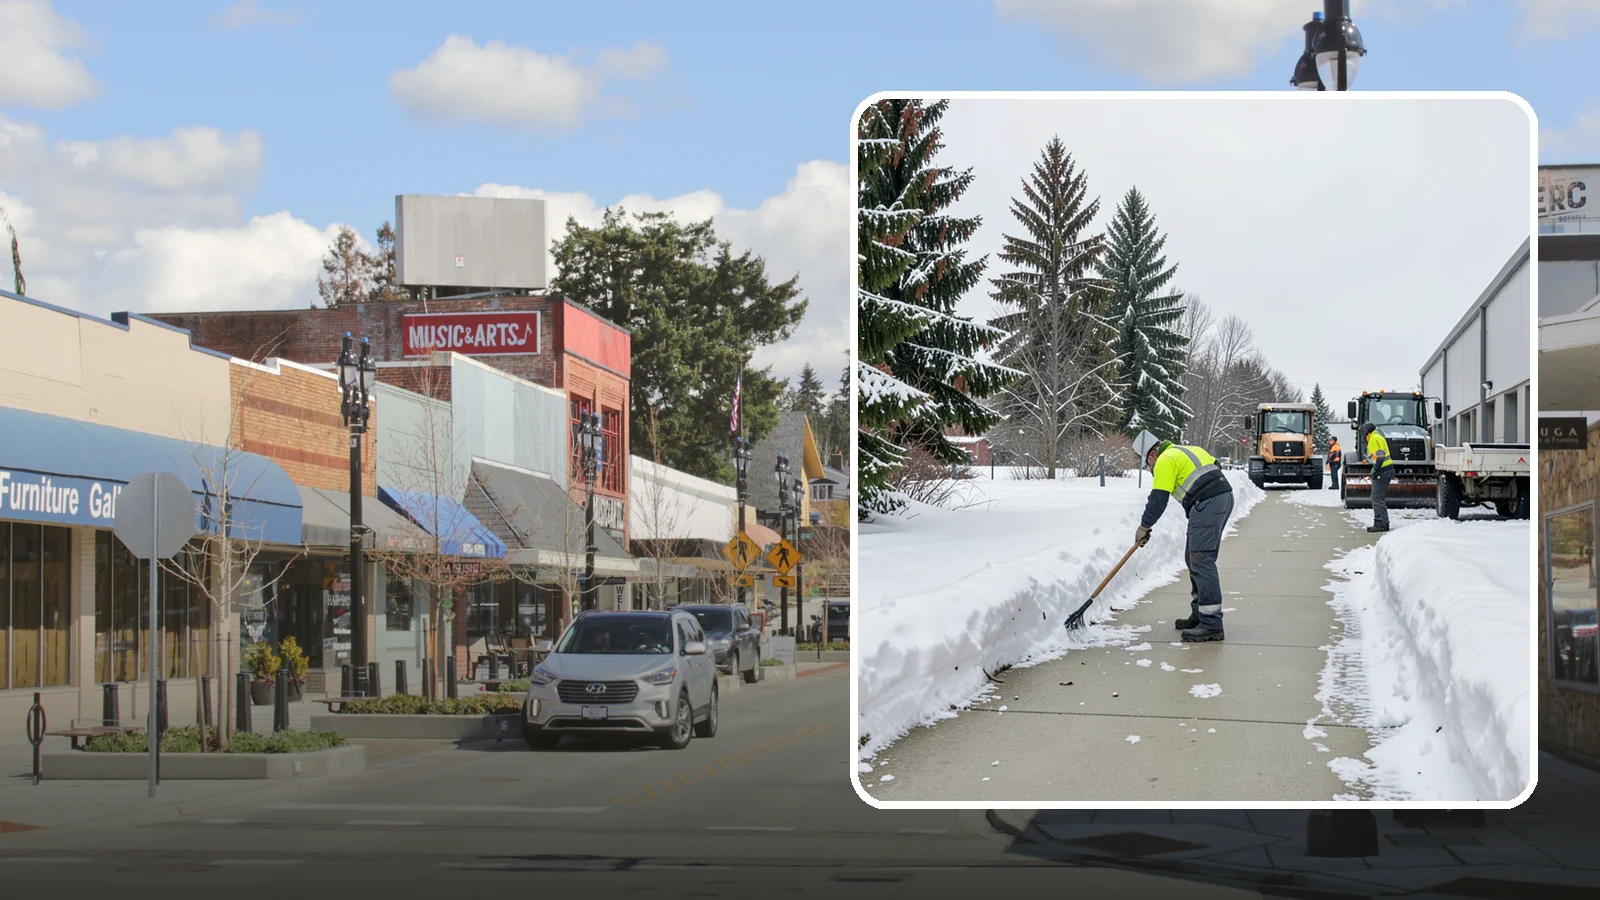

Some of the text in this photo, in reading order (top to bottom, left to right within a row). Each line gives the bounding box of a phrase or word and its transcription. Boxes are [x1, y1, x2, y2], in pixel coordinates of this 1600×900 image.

[1540, 427, 1578, 437] UGA
[0, 471, 122, 518] Furniture Gal
